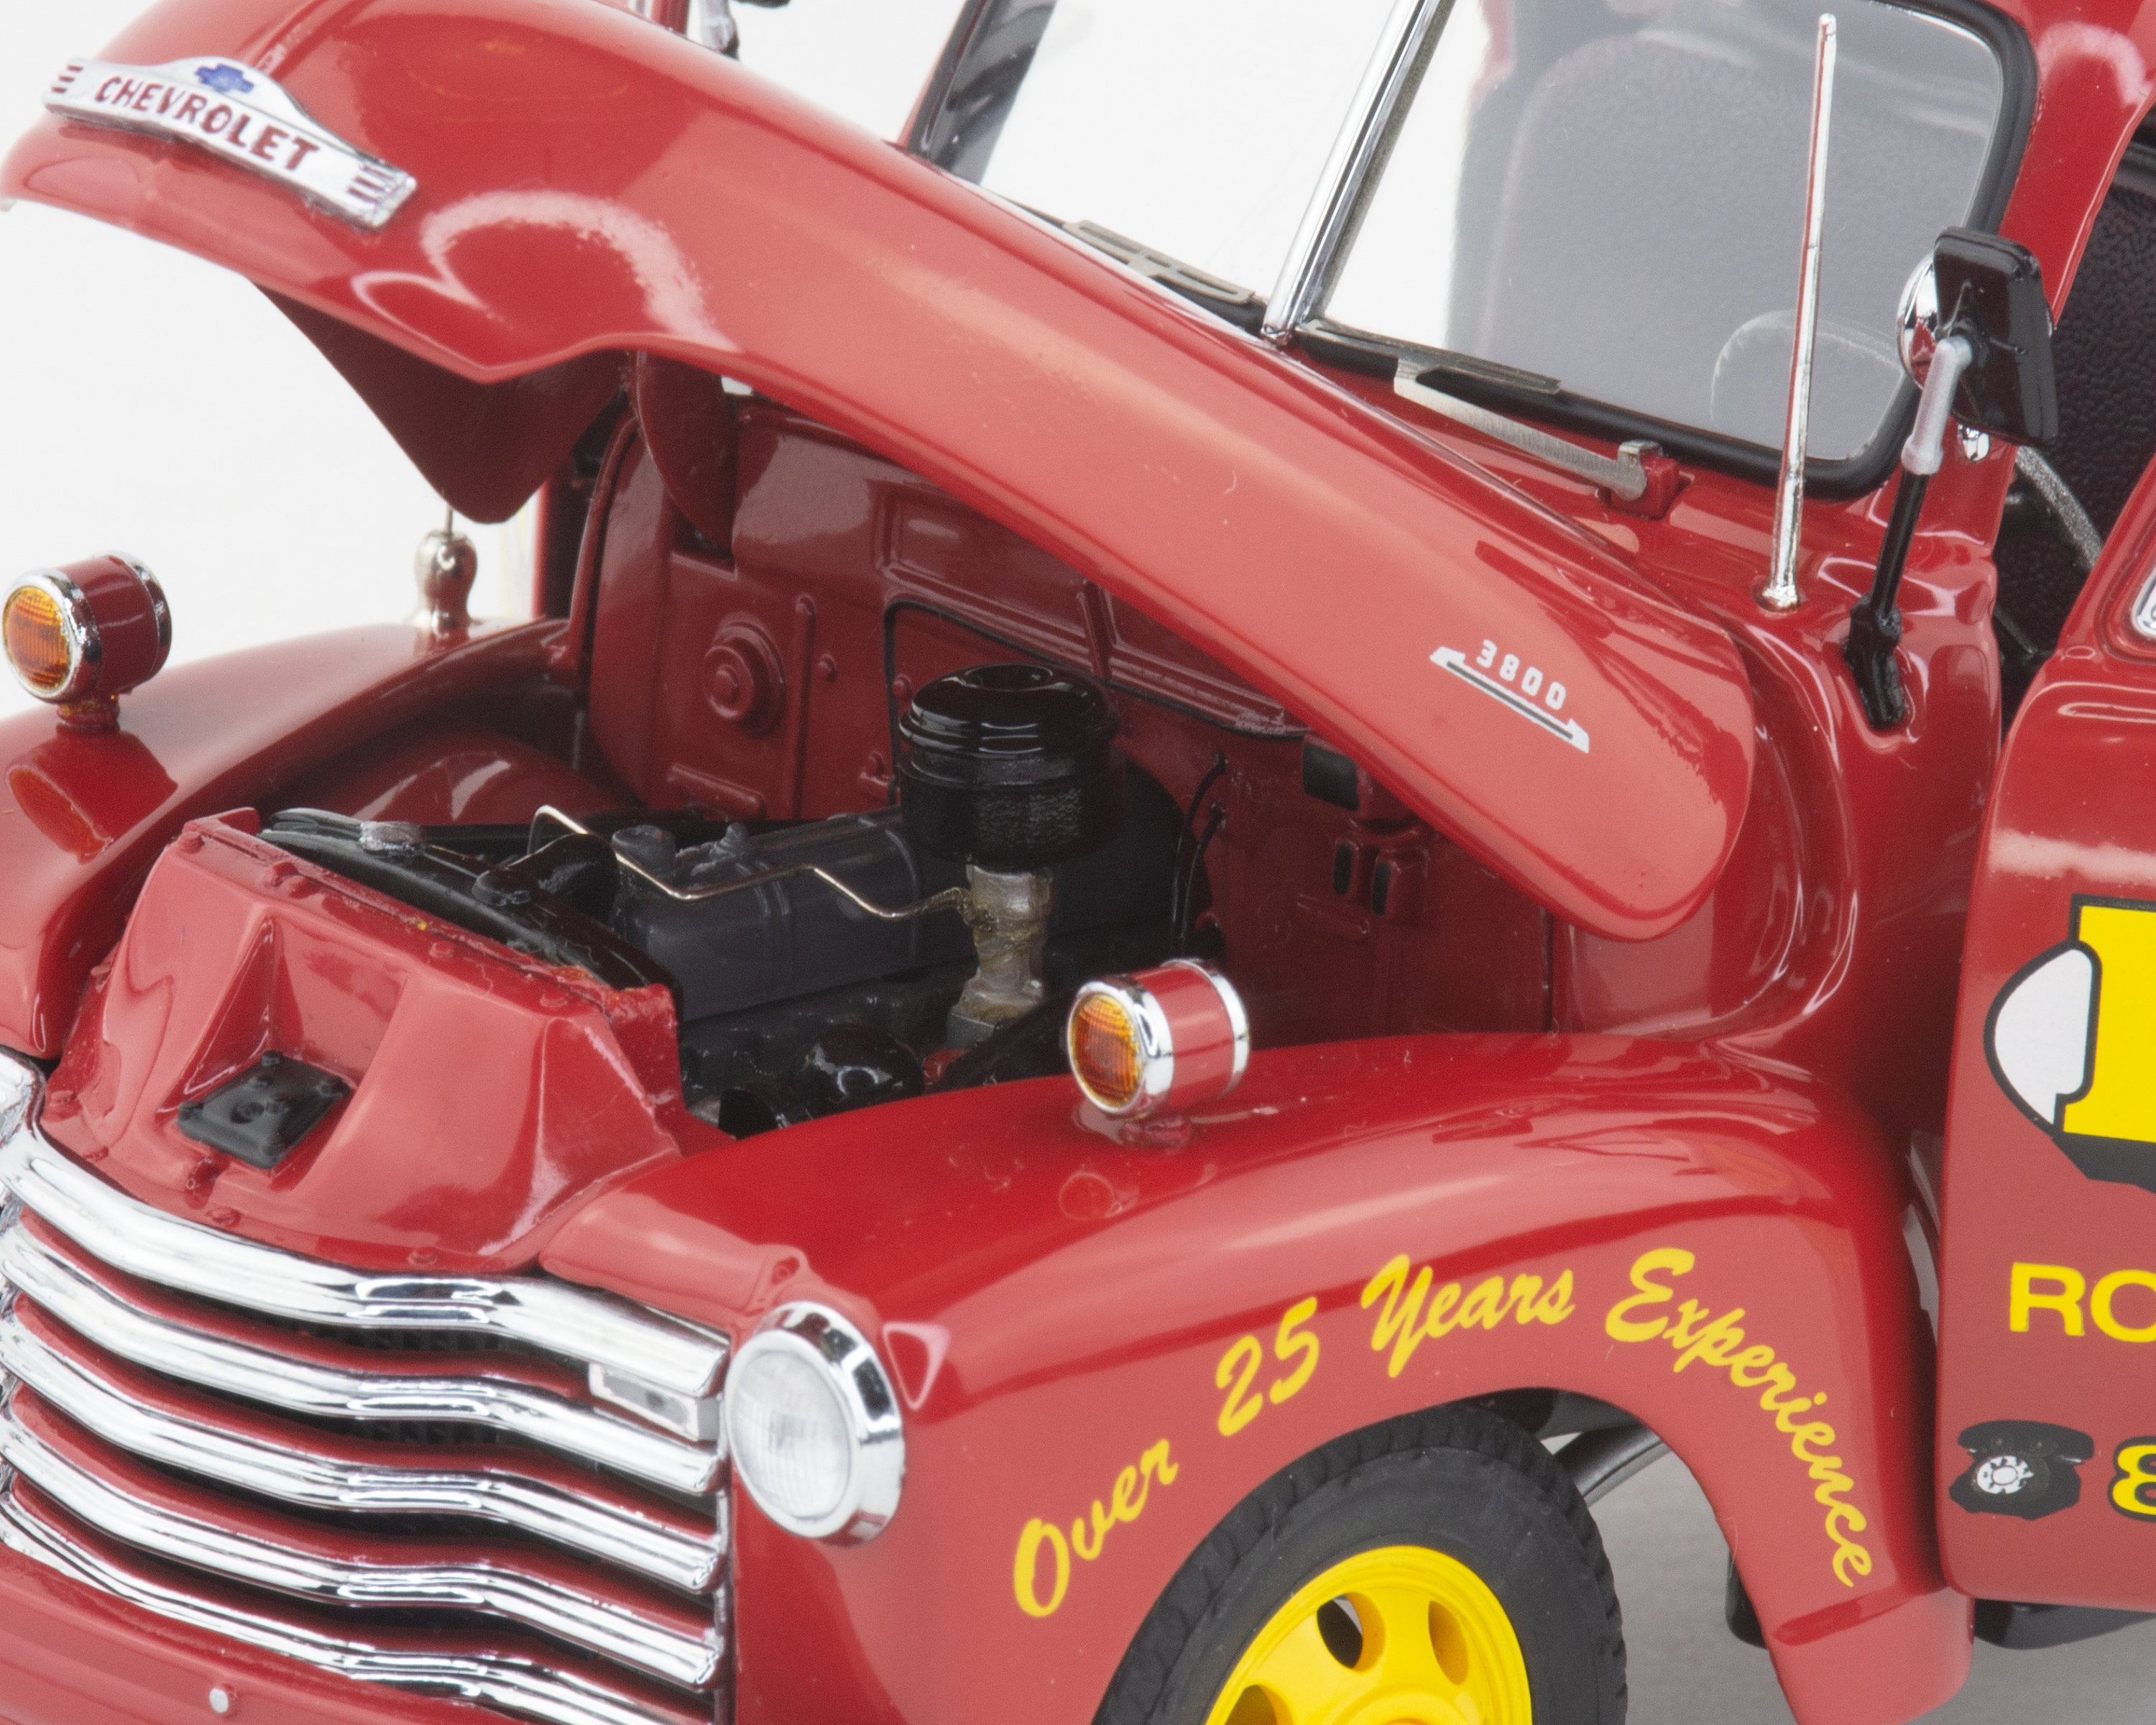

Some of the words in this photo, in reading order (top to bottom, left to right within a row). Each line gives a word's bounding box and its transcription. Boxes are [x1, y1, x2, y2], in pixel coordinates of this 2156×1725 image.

[94, 78, 319, 170] CHEVROLET
[1476, 639, 1567, 711] 3800
[2009, 1262, 2156, 1343] RO
[1013, 1440, 1179, 1617] Over
[1215, 1297, 1319, 1437] 25
[1360, 1254, 1575, 1378] Years
[1605, 1248, 1872, 1587] Experience
